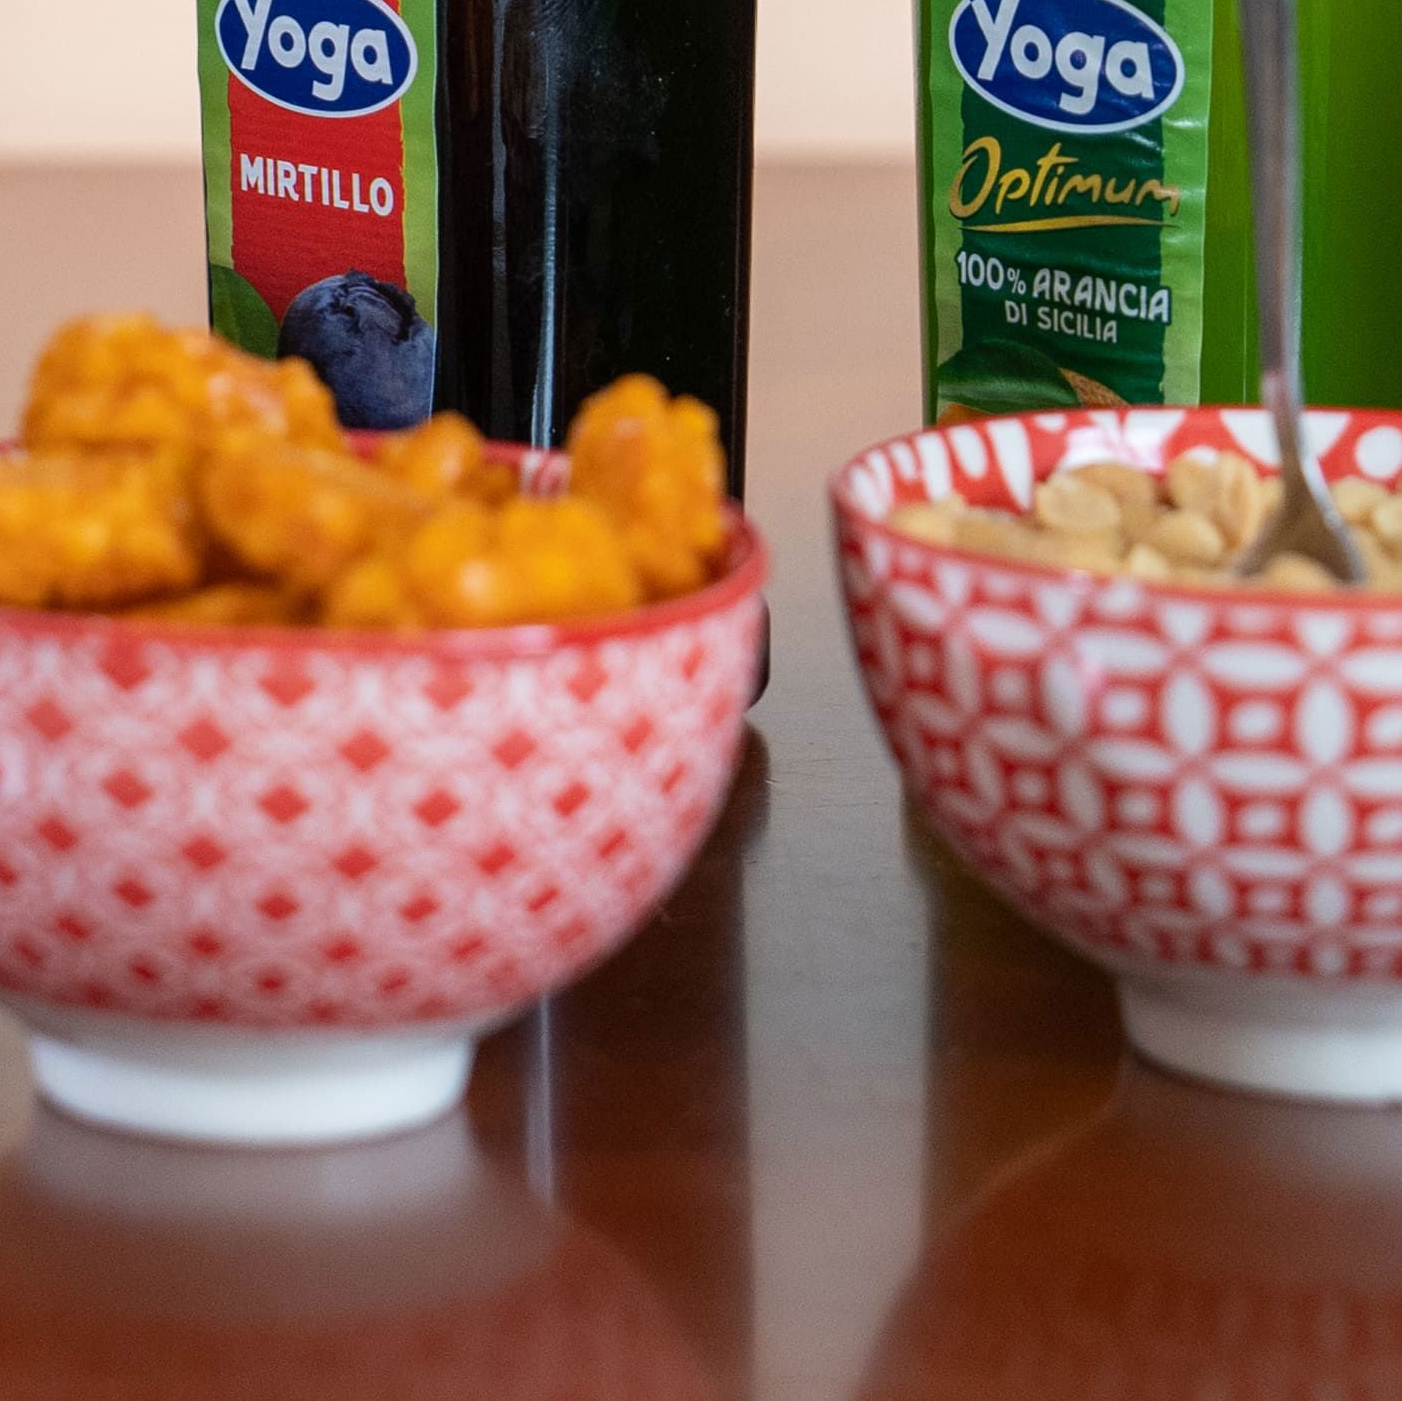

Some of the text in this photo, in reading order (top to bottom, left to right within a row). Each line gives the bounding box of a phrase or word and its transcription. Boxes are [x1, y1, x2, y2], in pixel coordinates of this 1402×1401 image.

[240, 152, 394, 217] MIRTILLO
[948, 135, 1181, 219] Optimum
[956, 250, 1171, 324] 100% ARANCIA
[1004, 299, 1118, 344] DI SICILIA
